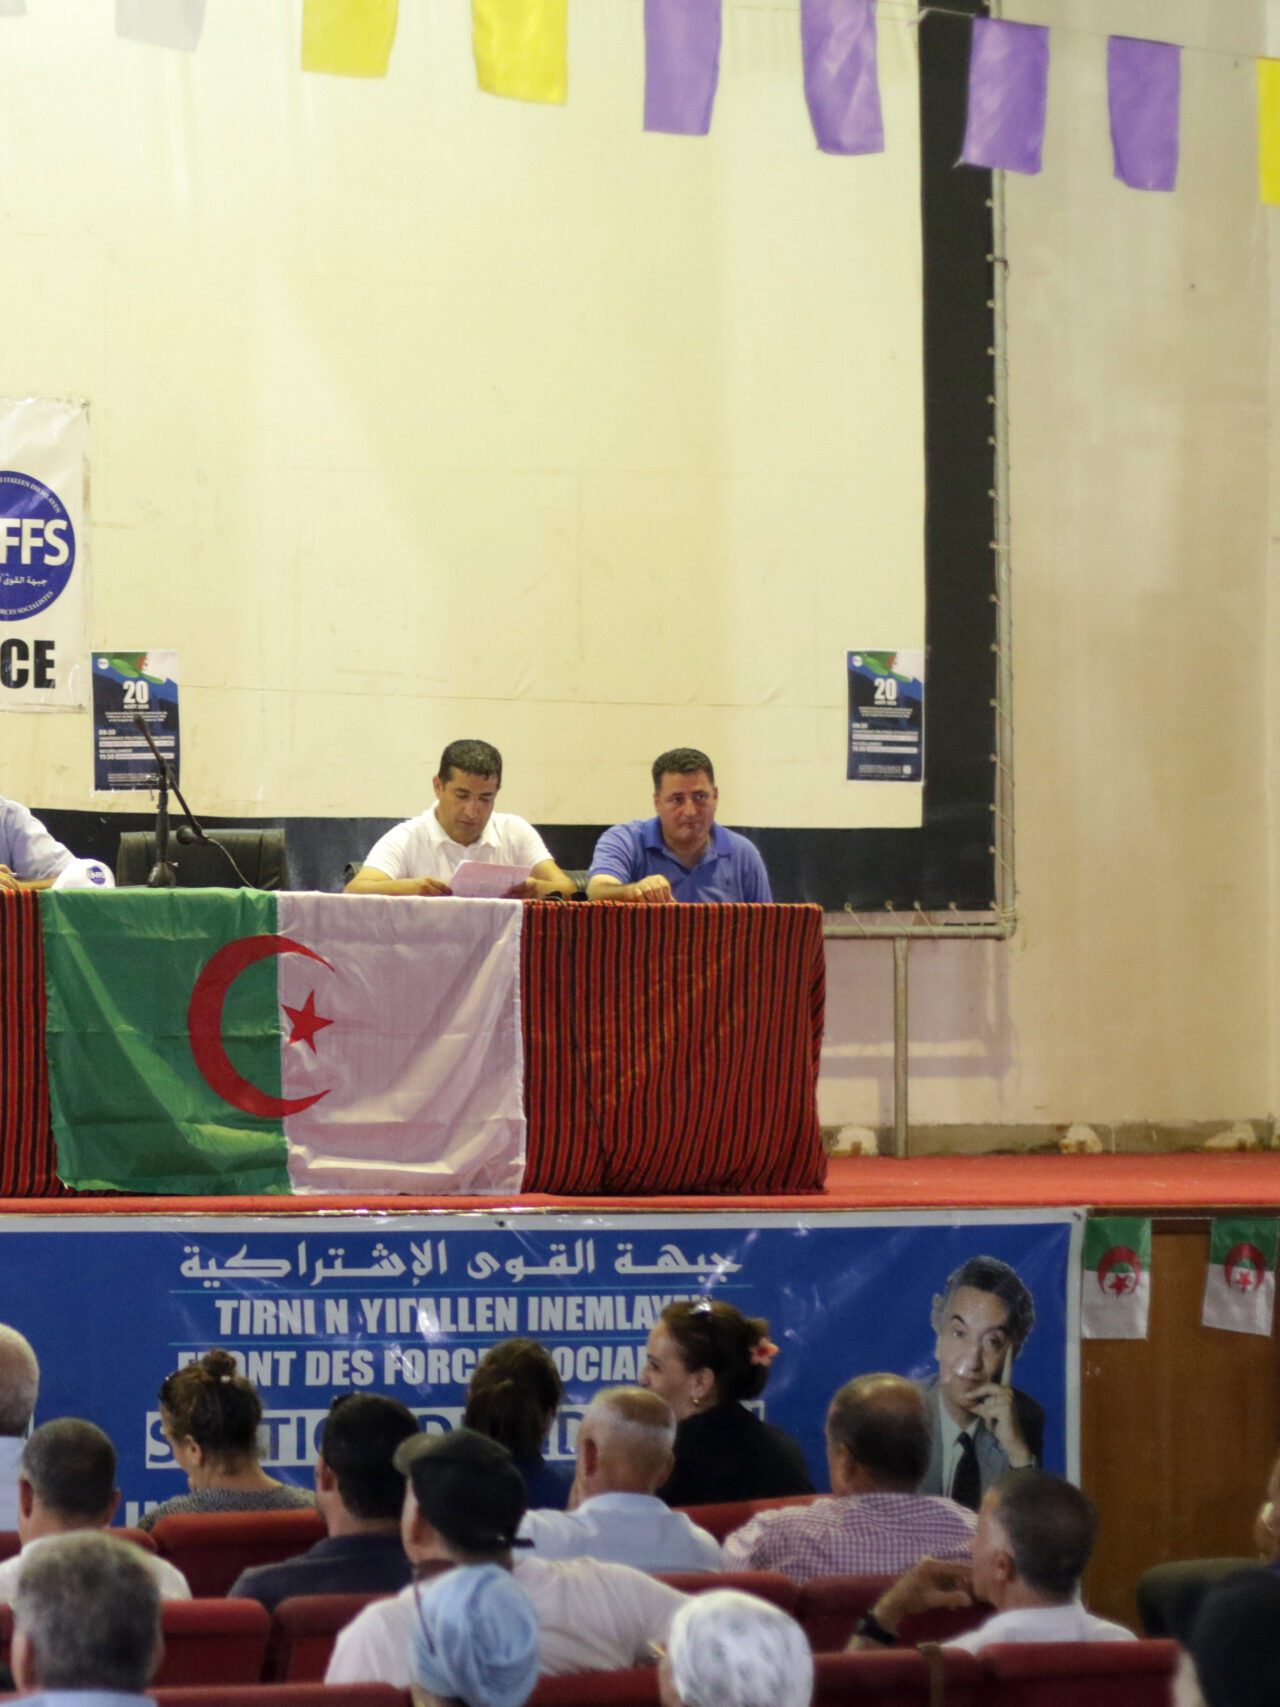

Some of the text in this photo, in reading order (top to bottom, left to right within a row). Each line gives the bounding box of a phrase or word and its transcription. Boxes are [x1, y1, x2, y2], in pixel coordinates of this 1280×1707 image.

[122, 680, 149, 704] 20
[874, 677, 897, 700] 20
[467, 1238, 596, 1283] القوى
[614, 1242, 743, 1283] جبهة
[215, 1298, 317, 1335] TIRNI
[325, 1298, 349, 1334] N
[305, 1349, 375, 1387] DES
